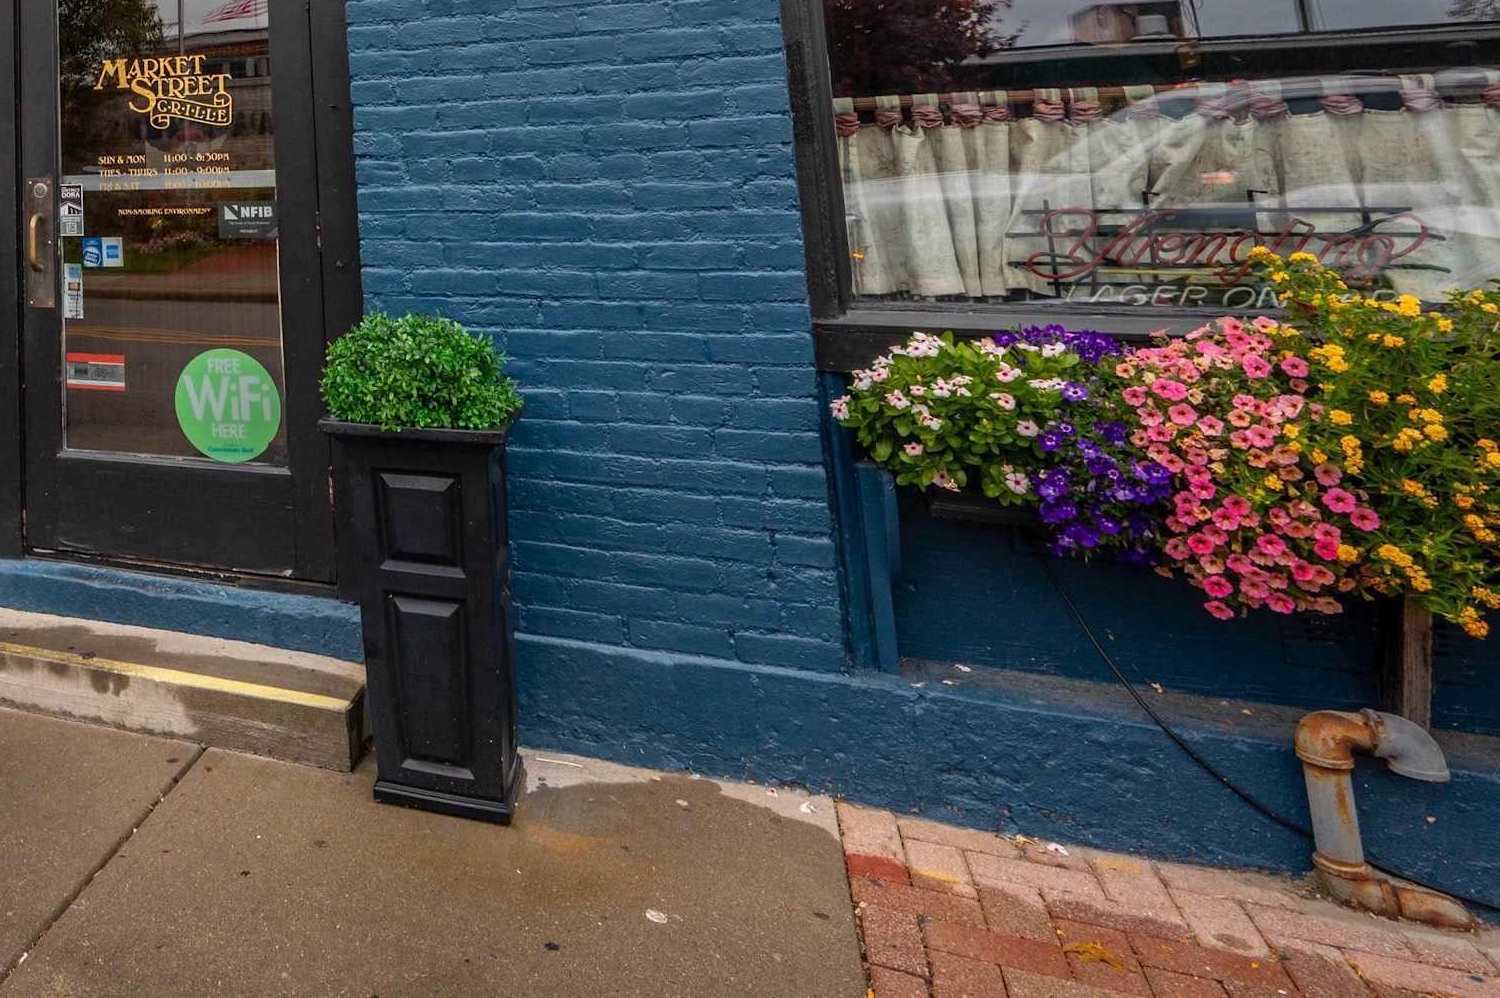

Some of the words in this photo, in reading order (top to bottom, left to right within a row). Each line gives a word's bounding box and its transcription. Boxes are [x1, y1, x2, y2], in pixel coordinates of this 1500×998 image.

[93, 55, 206, 90] MARKET
[129, 74, 232, 112] STREET
[98, 155, 116, 165] SUN
[117, 156, 125, 164] &
[163, 154, 187, 163] 11:00
[163, 167, 188, 175] 11:00
[240, 205, 273, 218] NFIB
[1065, 284, 1209, 308] LAGER
[207, 357, 241, 374] FREE
[183, 374, 272, 422] WiFi
[211, 423, 246, 439] HERE
